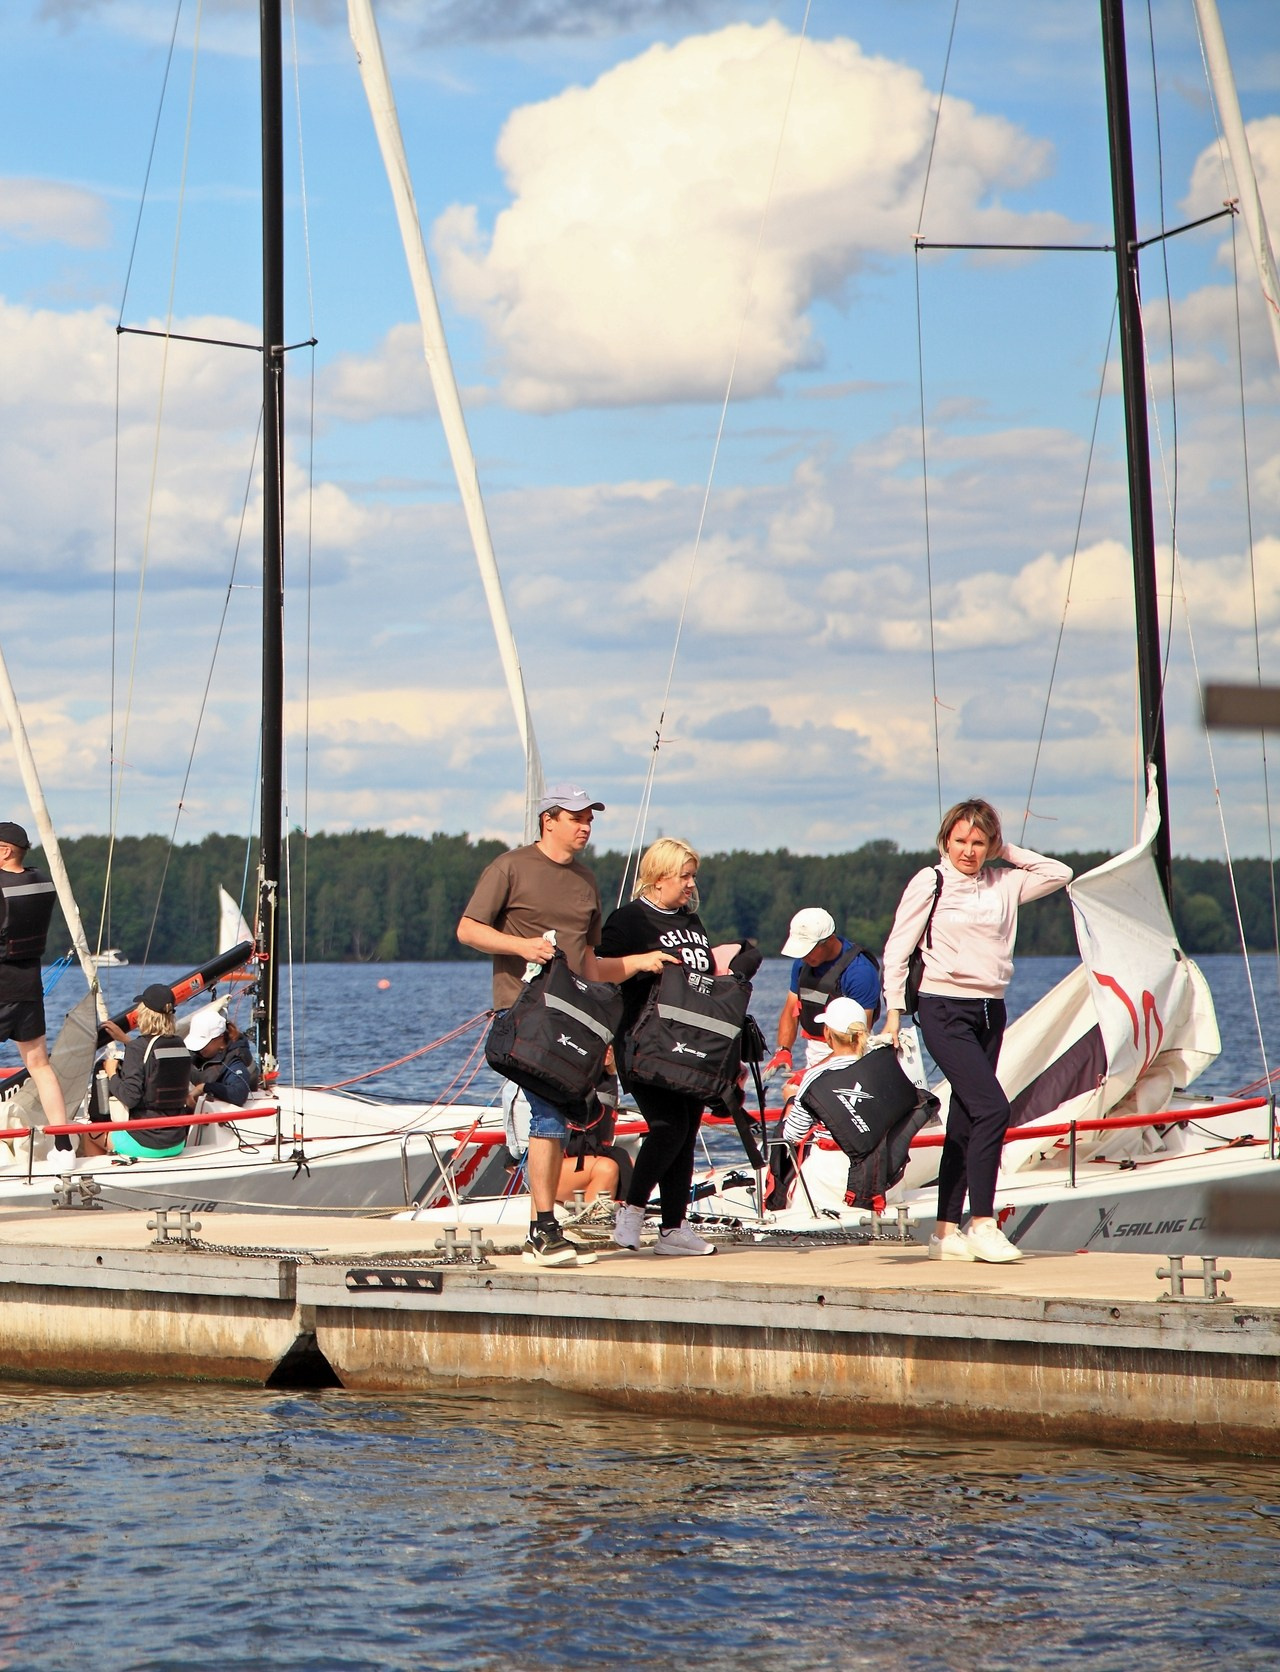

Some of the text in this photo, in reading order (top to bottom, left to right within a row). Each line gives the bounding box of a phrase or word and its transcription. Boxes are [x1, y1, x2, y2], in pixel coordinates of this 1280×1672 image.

[681, 947, 710, 972] 96
[836, 1094, 871, 1132] SAILING
[1112, 1219, 1187, 1238] SAILING
[1188, 1217, 1208, 1232] CL
